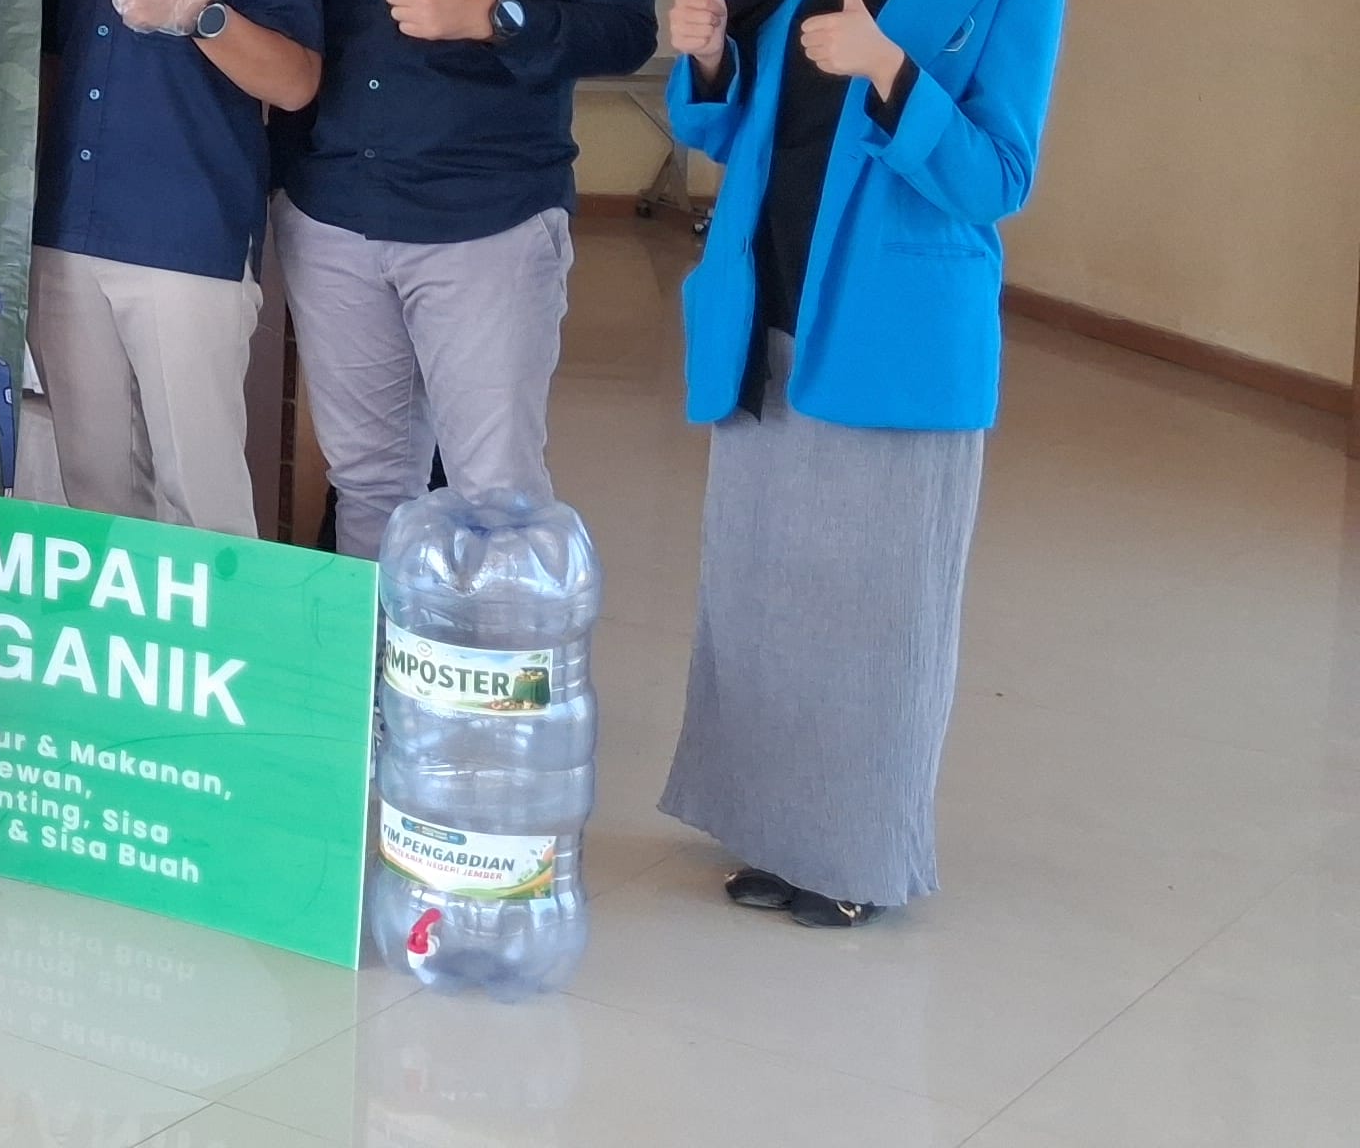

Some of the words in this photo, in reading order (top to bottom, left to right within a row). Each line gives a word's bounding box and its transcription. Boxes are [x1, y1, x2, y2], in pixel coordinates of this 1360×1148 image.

[37, 731, 61, 757] &
[70, 741, 234, 802] Makanan,
[8, 817, 29, 843] &
[41, 823, 108, 864] Sisa
[118, 842, 201, 887] Buah
[102, 807, 170, 847] Sisa
[402, 837, 516, 872] PENGABDIAN
